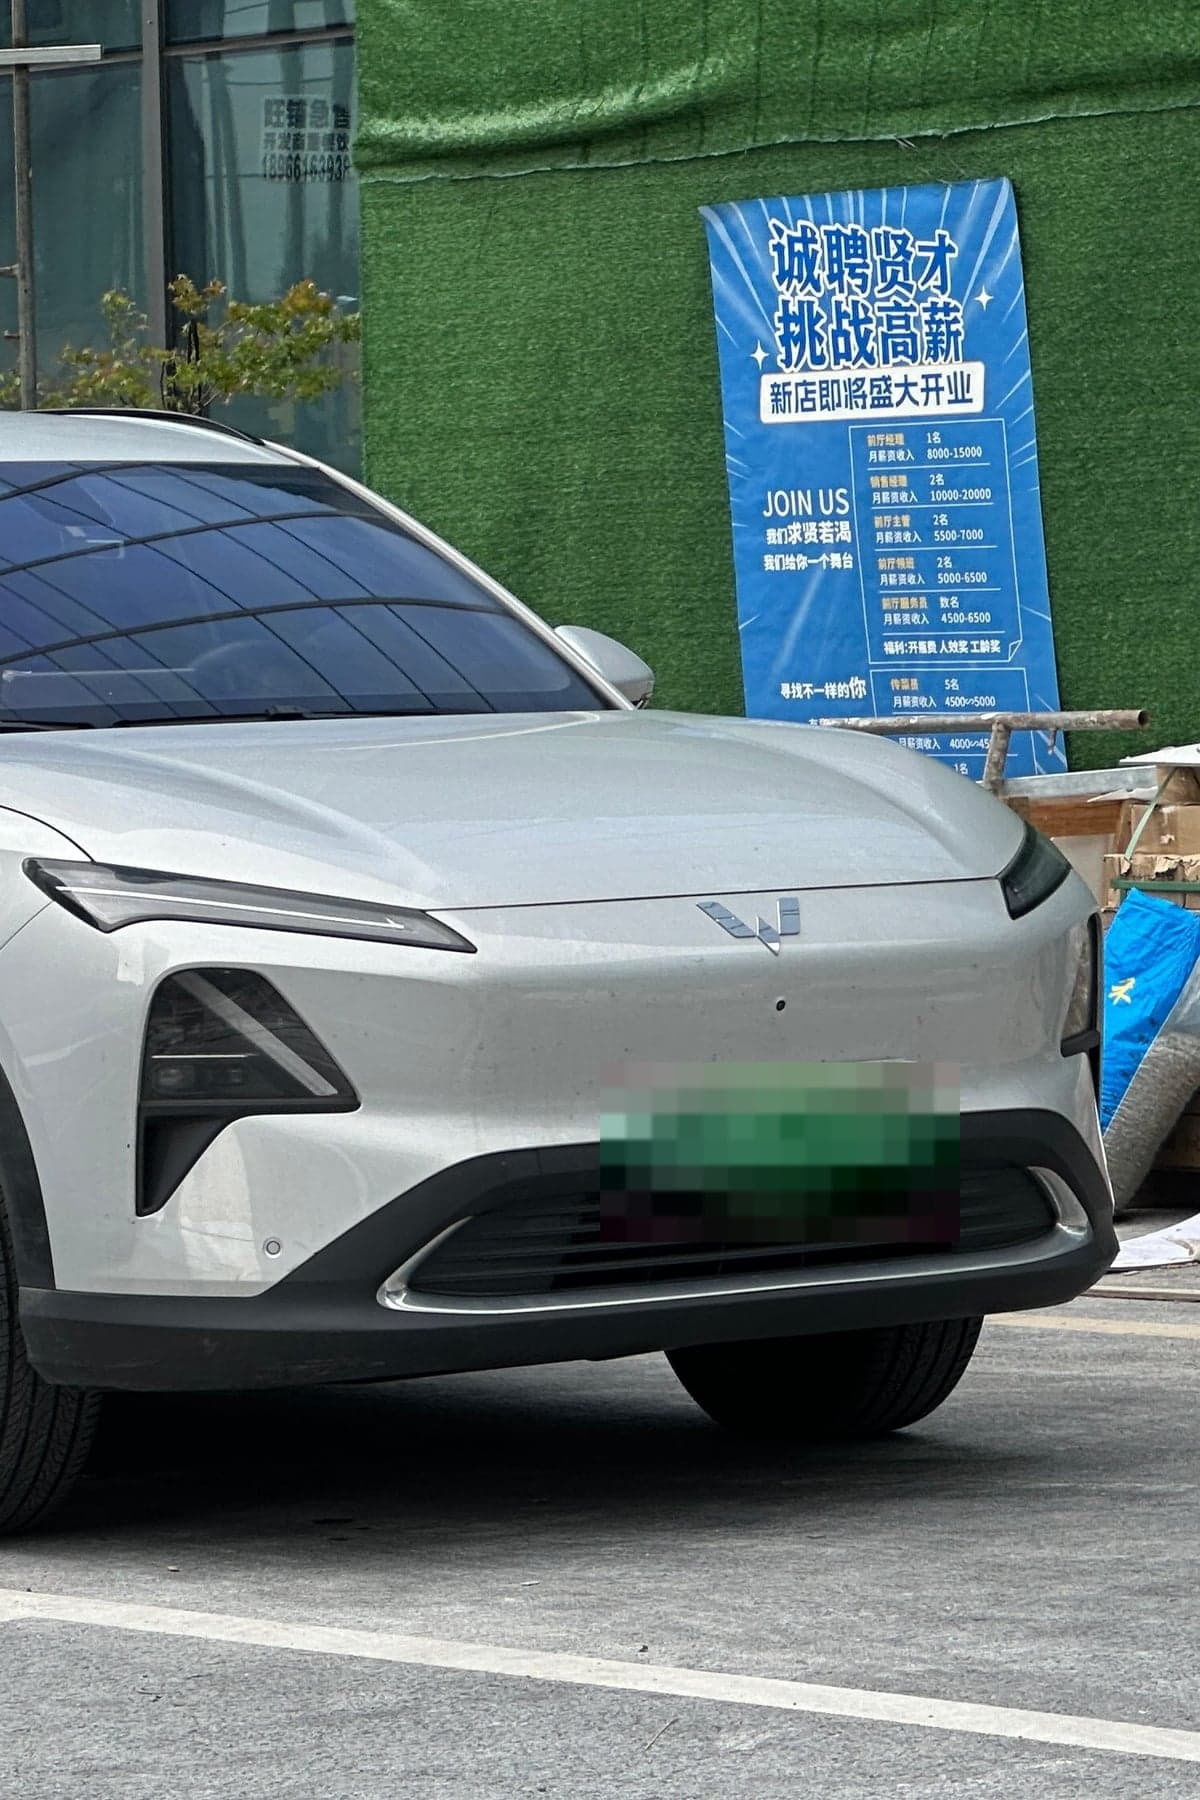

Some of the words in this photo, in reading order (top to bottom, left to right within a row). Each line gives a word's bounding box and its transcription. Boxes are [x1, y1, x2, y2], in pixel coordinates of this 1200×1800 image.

[770, 219, 958, 297] 诚聘贤才
[774, 297, 963, 371] 挑战高薪
[770, 371, 973, 414] 新店即将盛大开业
[926, 431, 941, 444] 1名
[869, 449, 915, 463] 月薪资收入
[927, 446, 982, 460] 8000-15000
[930, 473, 945, 486] 2名
[763, 489, 812, 517] JOIN
[818, 487, 850, 515] US
[872, 491, 918, 504] 月薪资收入
[930, 488, 992, 502] 10000-20000
[933, 514, 948, 526] 2名
[766, 520, 852, 545] 我们求贤若渴
[876, 531, 922, 544] 月薪资收入
[934, 529, 984, 541] 5500-7000
[763, 552, 853, 571] 我们给你一个舞台
[937, 556, 952, 569] 2名
[880, 573, 926, 587] 月薪资收入
[937, 572, 988, 584] 5000-6500
[939, 596, 960, 609] 数名
[883, 613, 929, 625] 月薪资收入
[941, 612, 991, 624] 4500-6500
[780, 676, 867, 700] 寻找不一样的你
[944, 678, 959, 690] 5名
[893, 696, 937, 708] 月薪资收入
